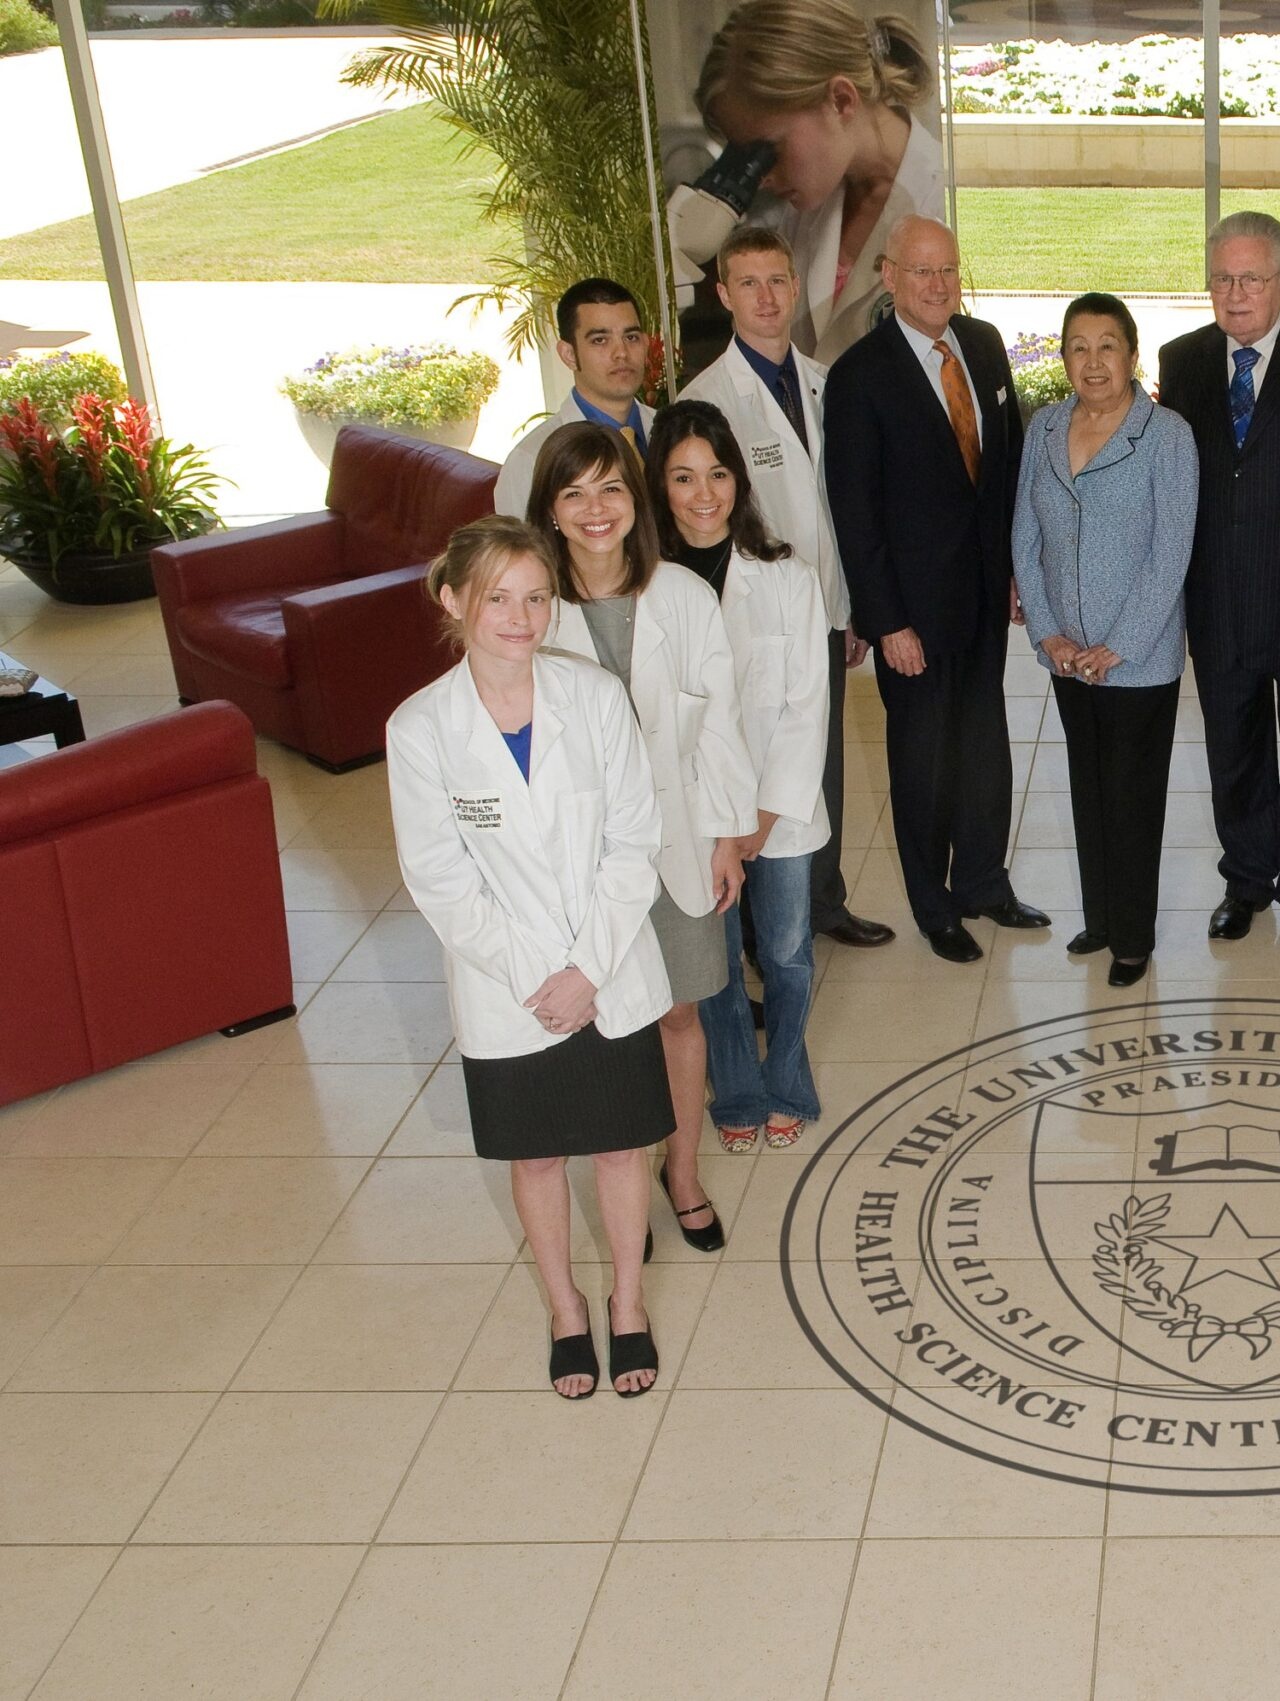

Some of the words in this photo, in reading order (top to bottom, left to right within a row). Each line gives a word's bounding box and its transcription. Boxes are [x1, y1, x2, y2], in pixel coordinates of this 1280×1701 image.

[457, 813, 478, 822] SCIENCE
[478, 813, 502, 822] CENTER
[469, 805, 493, 814] HEALTH
[878, 1106, 977, 1171] THE
[947, 1173, 1086, 1357] DISCIPLINA
[856, 1191, 913, 1316] HEALTH
[895, 1322, 1086, 1428] SCIENCE
